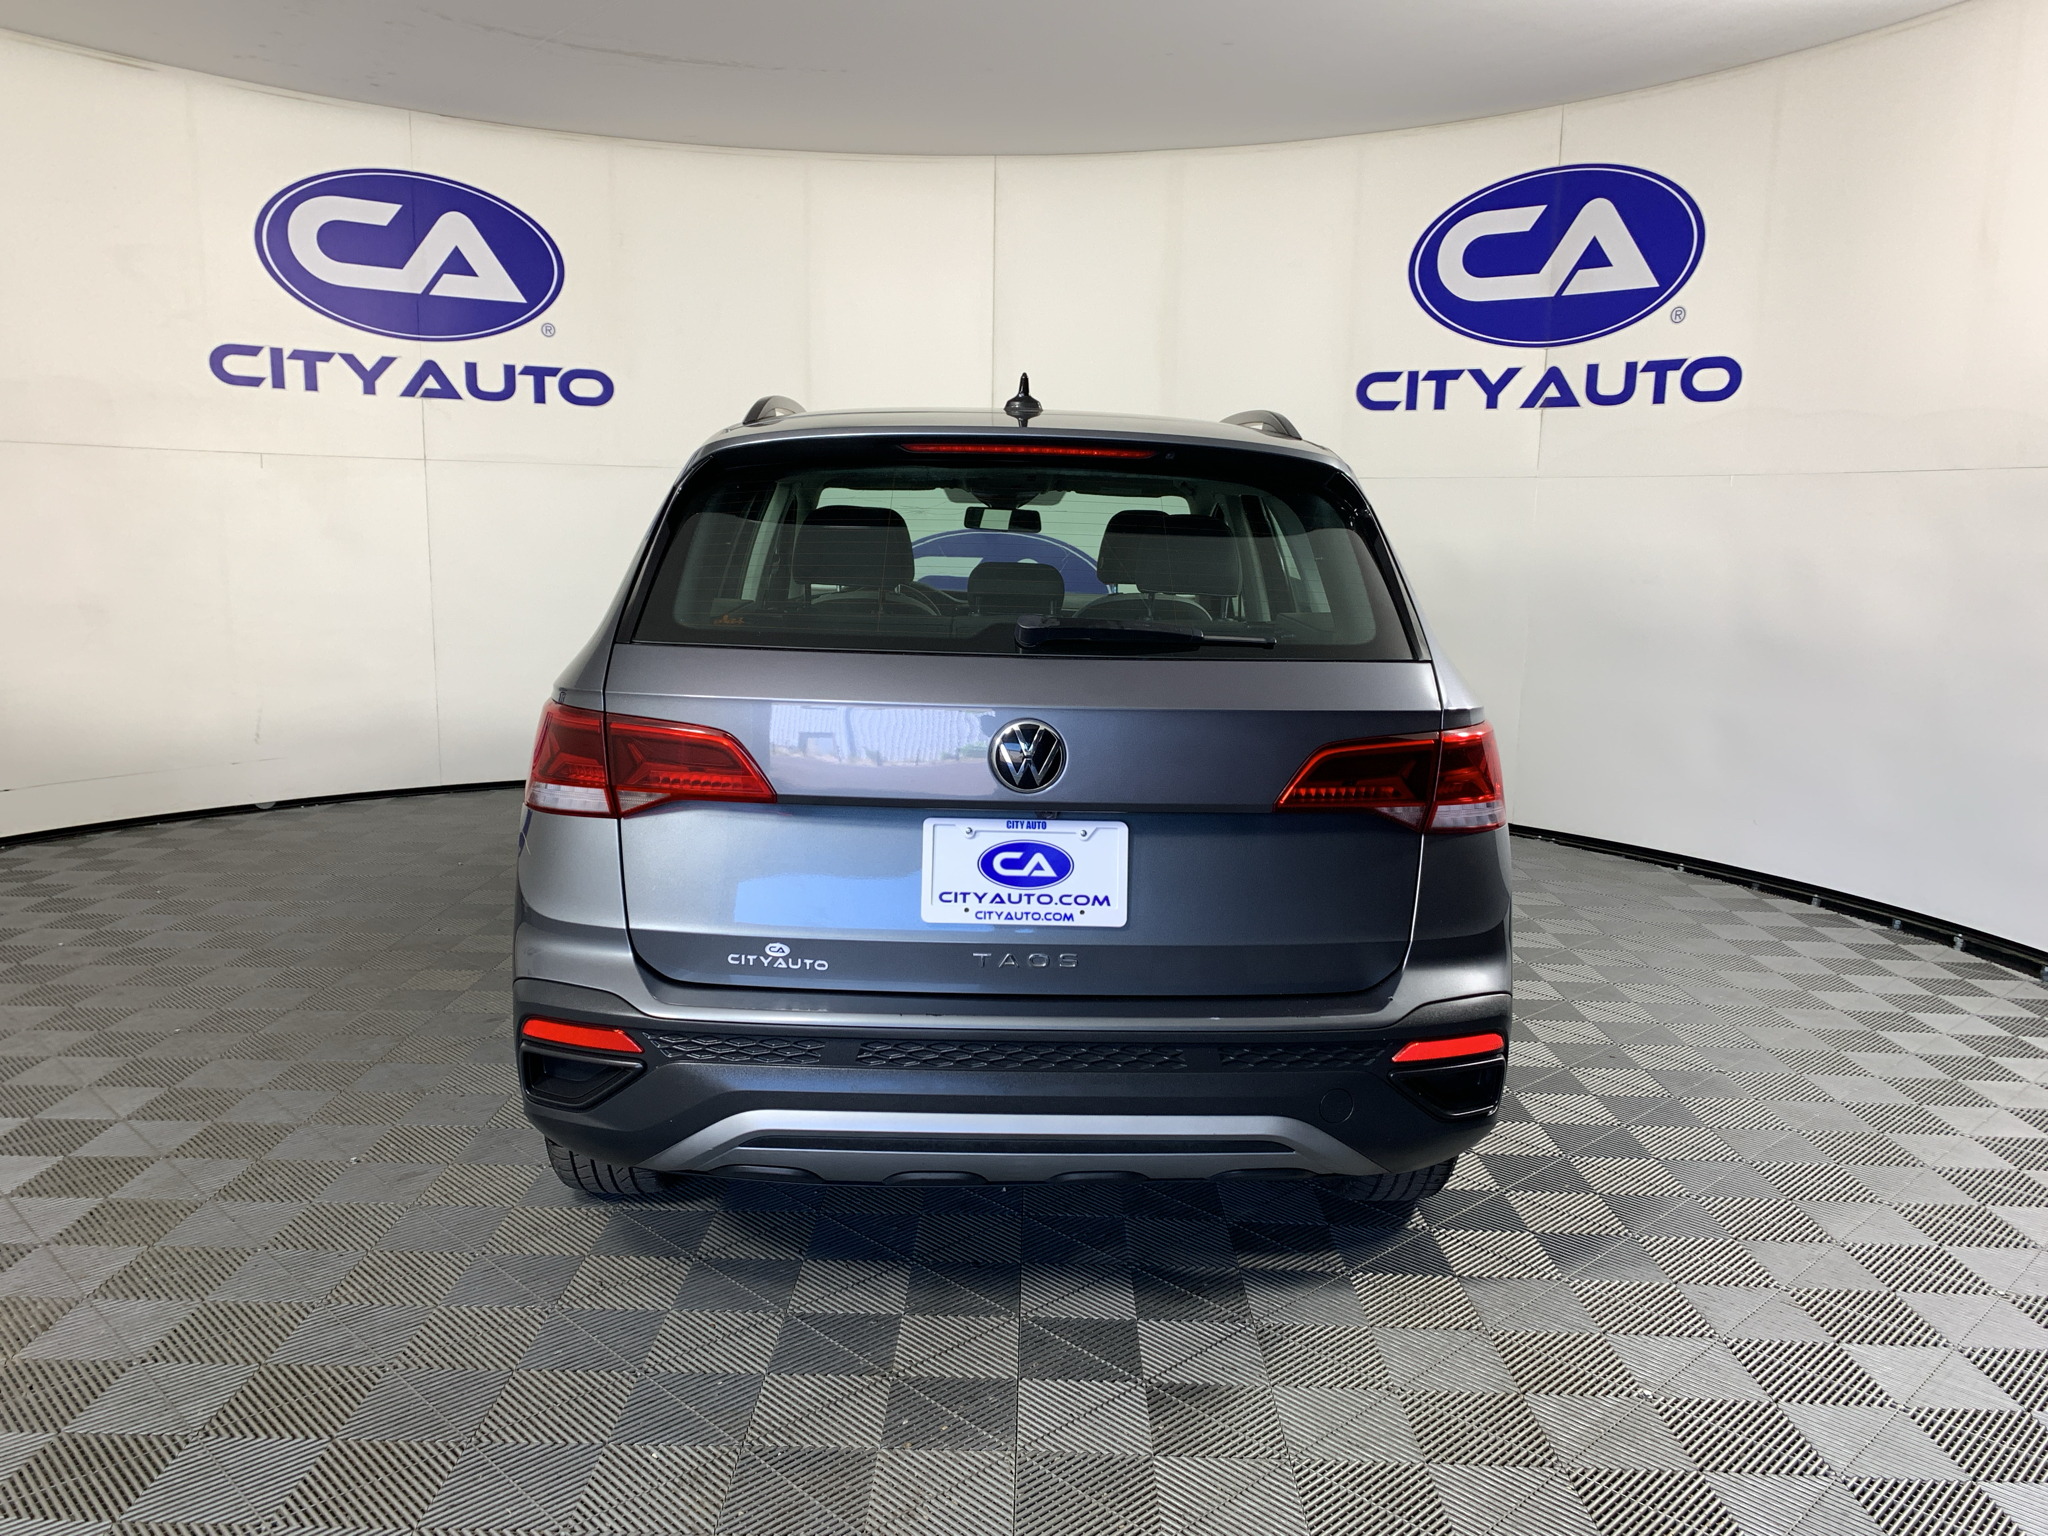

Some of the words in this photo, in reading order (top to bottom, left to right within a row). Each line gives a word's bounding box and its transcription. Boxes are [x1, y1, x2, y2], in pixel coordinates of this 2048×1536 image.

[288, 195, 527, 303] CA
[1437, 197, 1660, 302] CA
[1006, 820, 1025, 829] CITY
[1026, 821, 1047, 830] AUTO
[992, 851, 1058, 877] CA
[769, 946, 786, 954] CA
[972, 953, 1078, 968] TAOS
